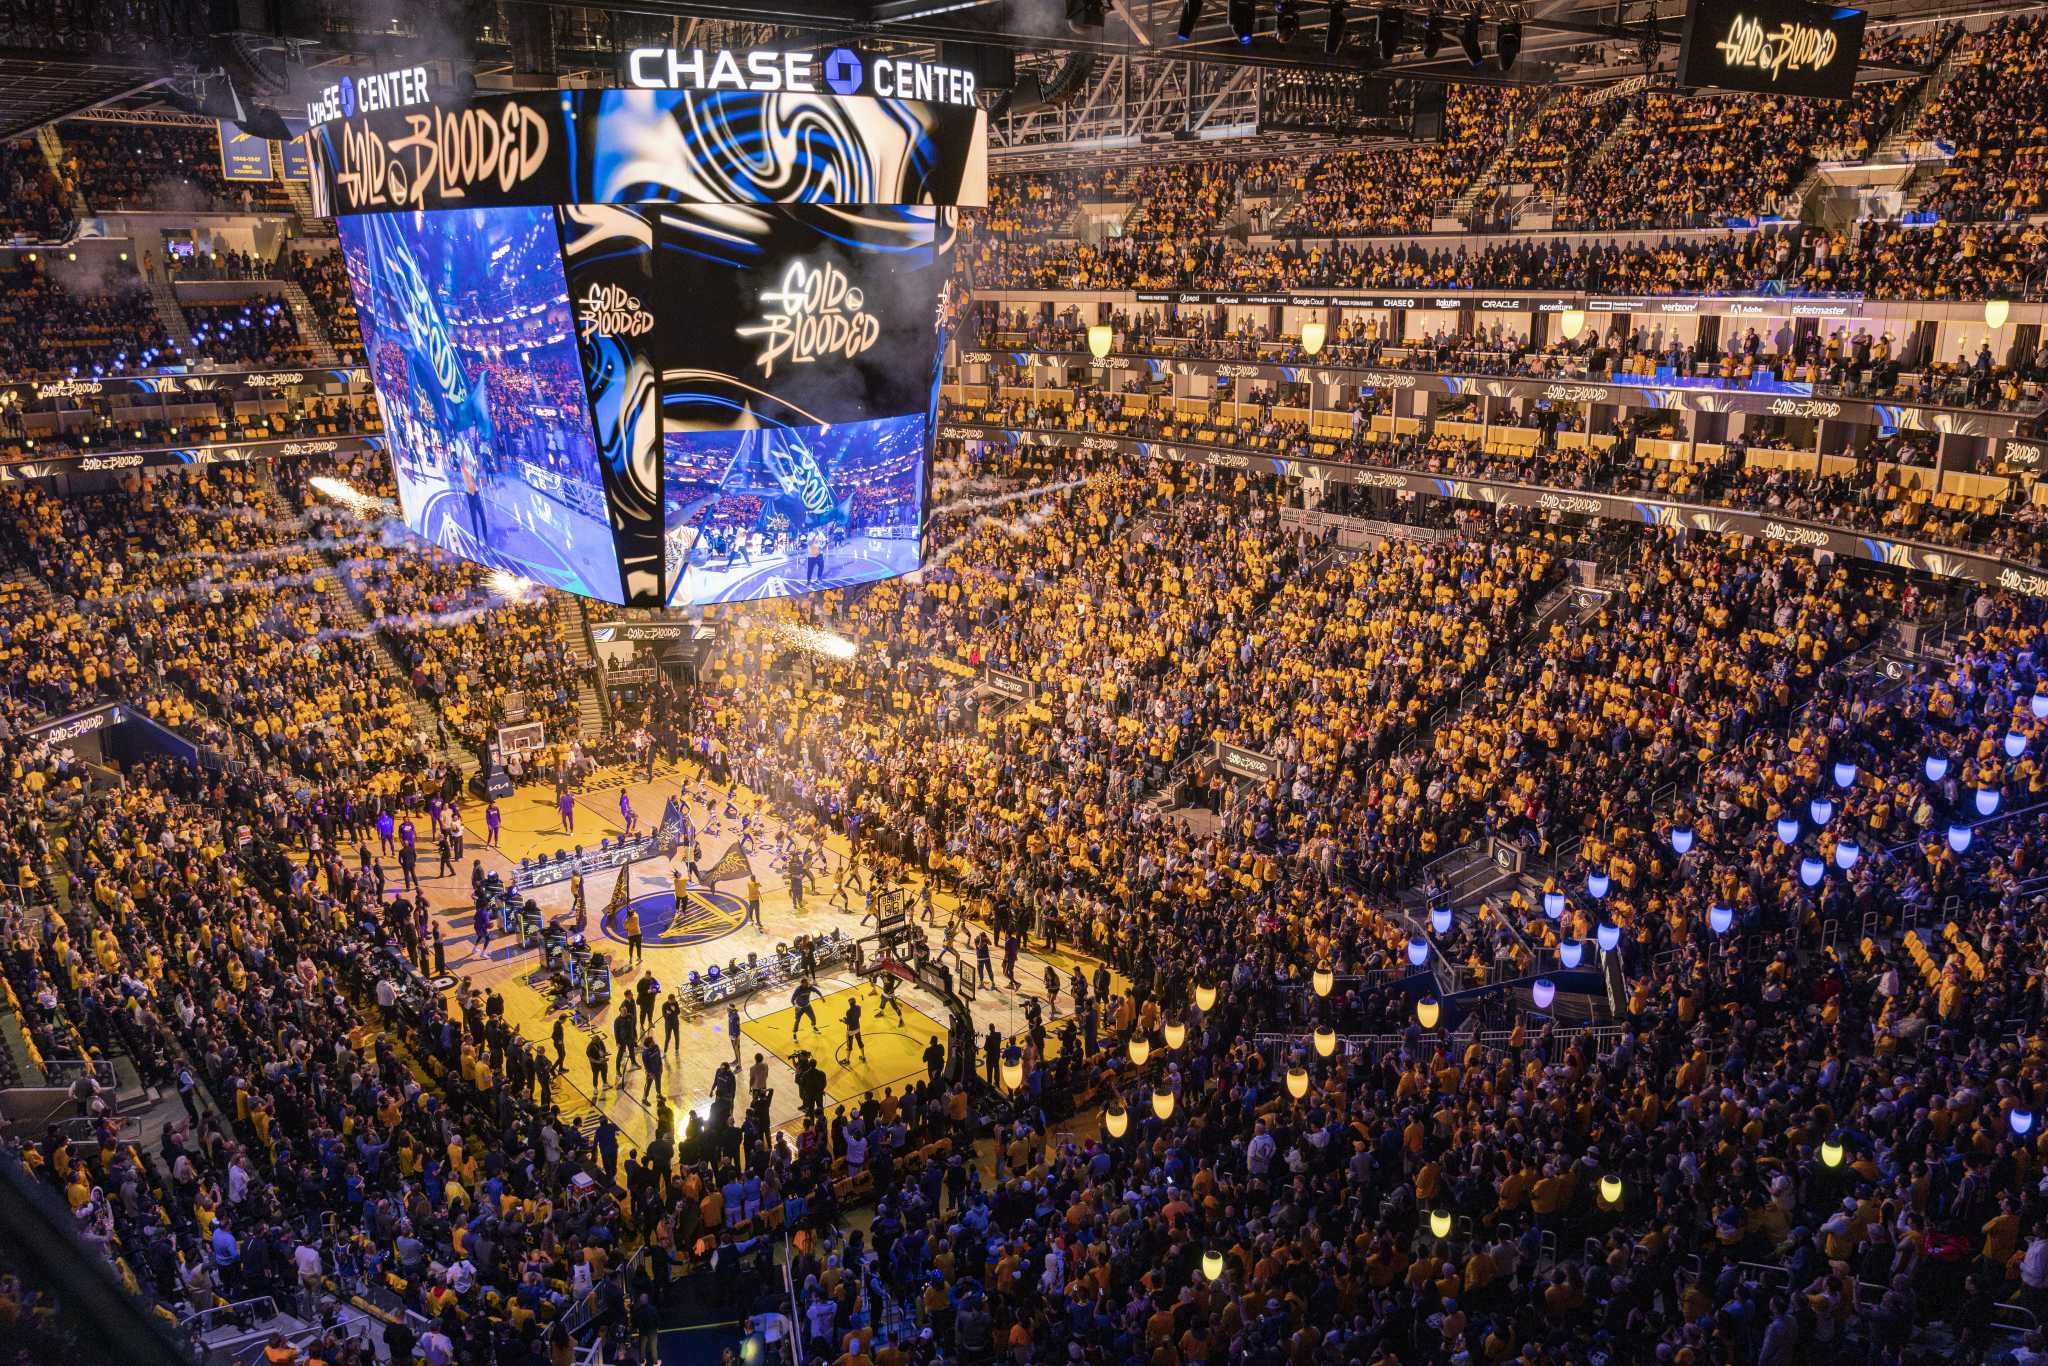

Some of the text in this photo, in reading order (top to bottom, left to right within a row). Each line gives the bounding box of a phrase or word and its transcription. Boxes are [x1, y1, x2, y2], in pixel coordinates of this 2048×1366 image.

[1716, 14, 1837, 82] GOLD BLOODED
[629, 48, 976, 107] CHASE CENTER
[357, 67, 430, 113] CENTER
[338, 101, 549, 210] GOLD BLOODED
[760, 261, 847, 314] GOLD
[579, 282, 627, 312] GOLD
[1293, 297, 1310, 306] Google
[1436, 299, 1461, 308] Rakuten
[1482, 301, 1520, 309] ORACLE
[1662, 303, 1694, 312] verizon
[1792, 305, 1847, 315] ticketmaster
[579, 310, 654, 344] BLOODED
[735, 312, 880, 378] BLOODED
[1089, 358, 1130, 368] GOLD BLOODED
[1216, 364, 1259, 377] GOLD BLOODED
[244, 373, 304, 387] GOLD BLOODED
[1363, 372, 1416, 388] GOLD BLOODED
[41, 383, 103, 397] GOLD BLOODED
[1543, 384, 1608, 402] GOLD BLOODED
[1766, 398, 1841, 418] GOLD BLOODED
[280, 442, 338, 455] GOLD BLOODED
[2004, 441, 2040, 464] BLOODED
[78, 455, 144, 470] GOLD BLOODED
[1206, 452, 1249, 467] GOLD BLOODED
[1354, 470, 1407, 487] GOLD BLOODED
[1536, 493, 1601, 512] GOLD BLOODED
[1761, 521, 1829, 546] GOLD BLOODED
[1996, 567, 2048, 597] GOLD BLOO
[624, 627, 681, 640] GOLD BLOODED
[45, 715, 104, 744] GOLD BLOODED
